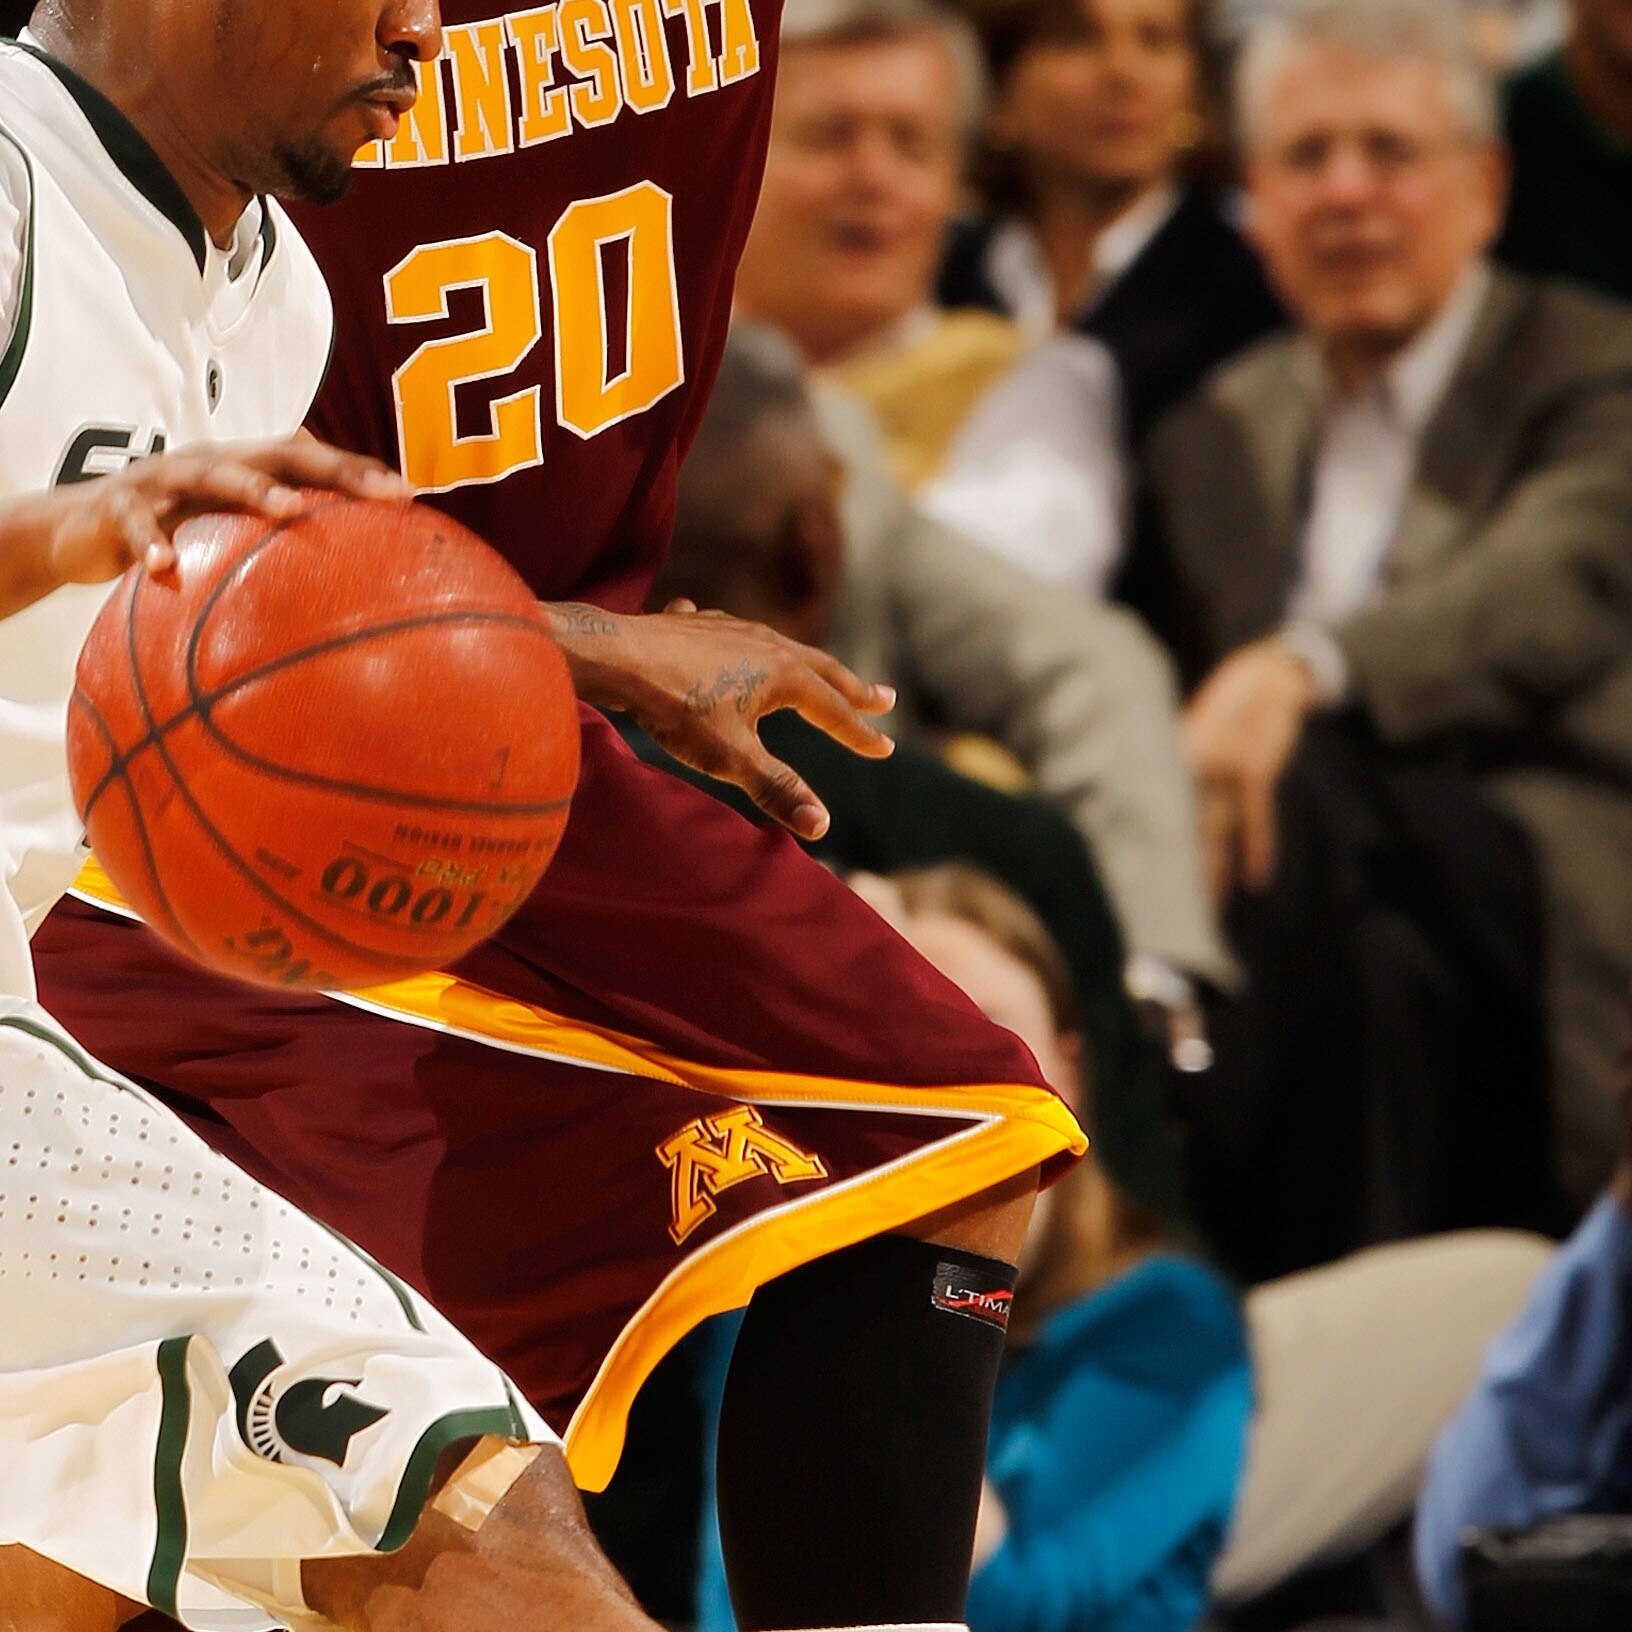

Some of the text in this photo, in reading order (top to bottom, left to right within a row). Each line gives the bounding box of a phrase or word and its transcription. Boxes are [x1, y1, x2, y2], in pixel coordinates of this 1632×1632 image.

[382, 179, 685, 497] 20
[321, 855, 488, 929] 1000
[655, 1103, 829, 1246] M
